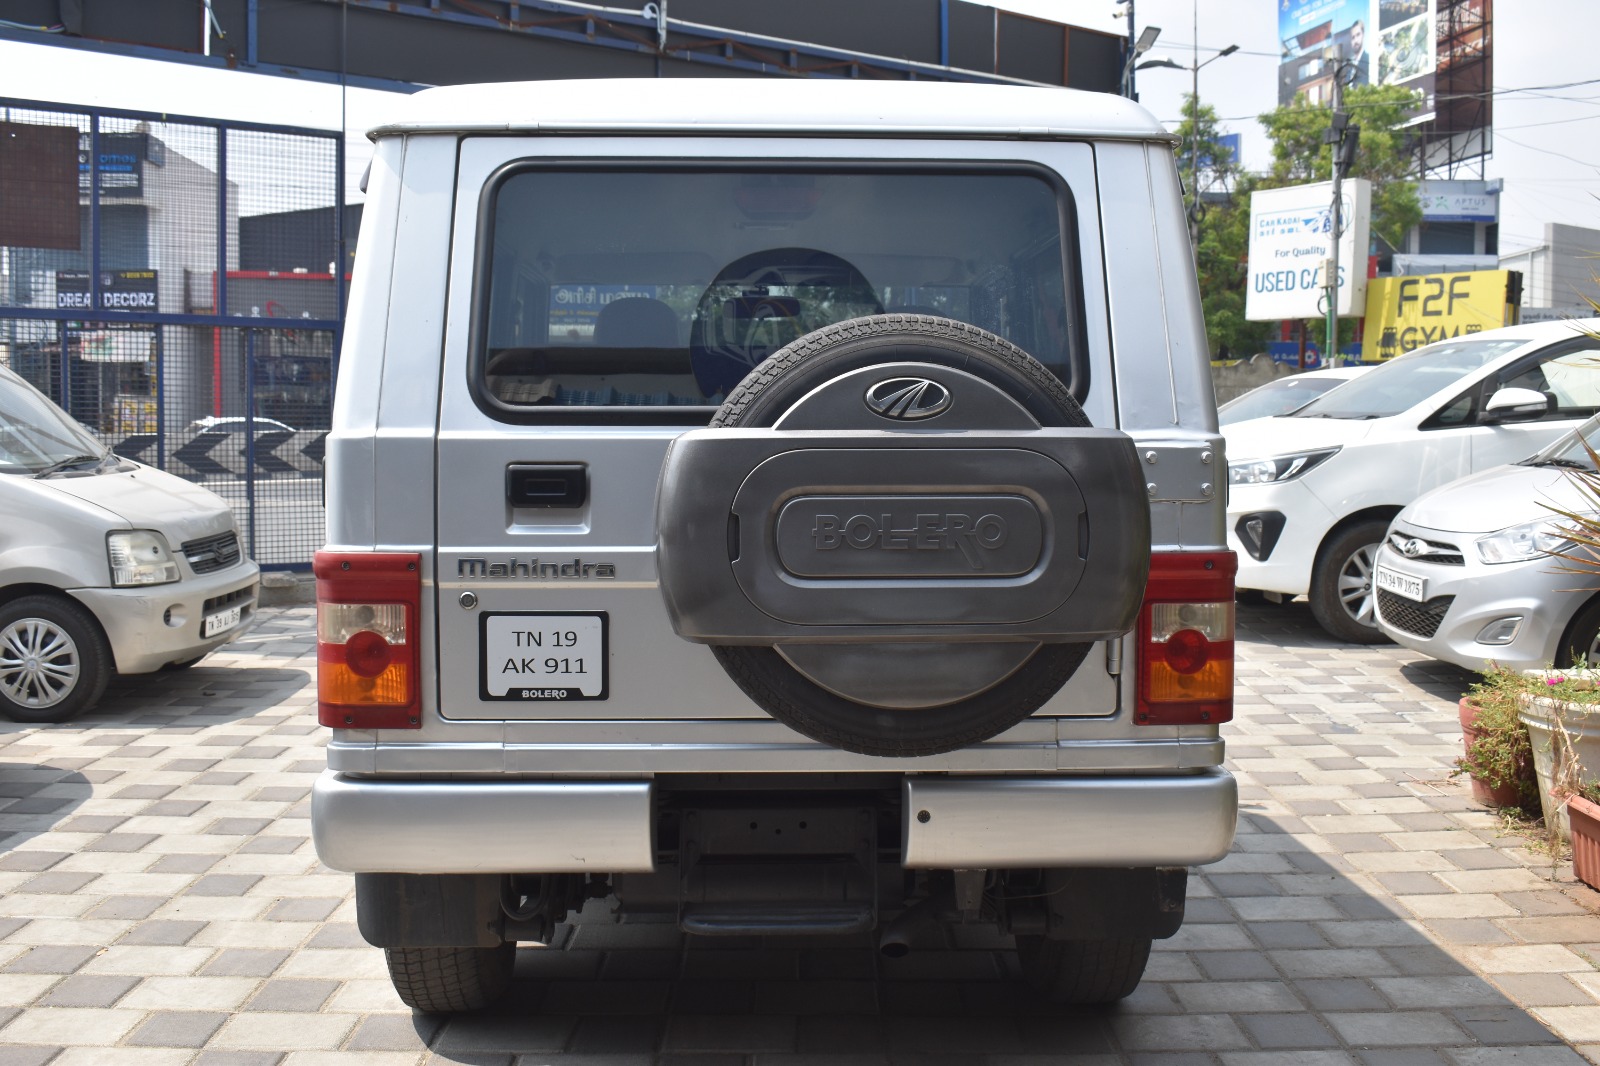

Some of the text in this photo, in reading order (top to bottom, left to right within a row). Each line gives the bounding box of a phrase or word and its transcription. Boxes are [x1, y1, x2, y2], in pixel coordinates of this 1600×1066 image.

[1454, 198, 1486, 207] APTUS
[1275, 245, 1326, 258] For Quality
[1255, 265, 1345, 293] USED CAS
[57, 292, 156, 308] DREA DECORZ
[1397, 275, 1471, 318] F2F
[811, 513, 1008, 569] BOLERO
[457, 557, 616, 579] Mahindra
[1379, 570, 1389, 584] TN
[1396, 576, 1404, 589] W
[512, 631, 577, 647] TN 19
[502, 658, 587, 674] AK 911
[522, 690, 567, 699] BOLERO
